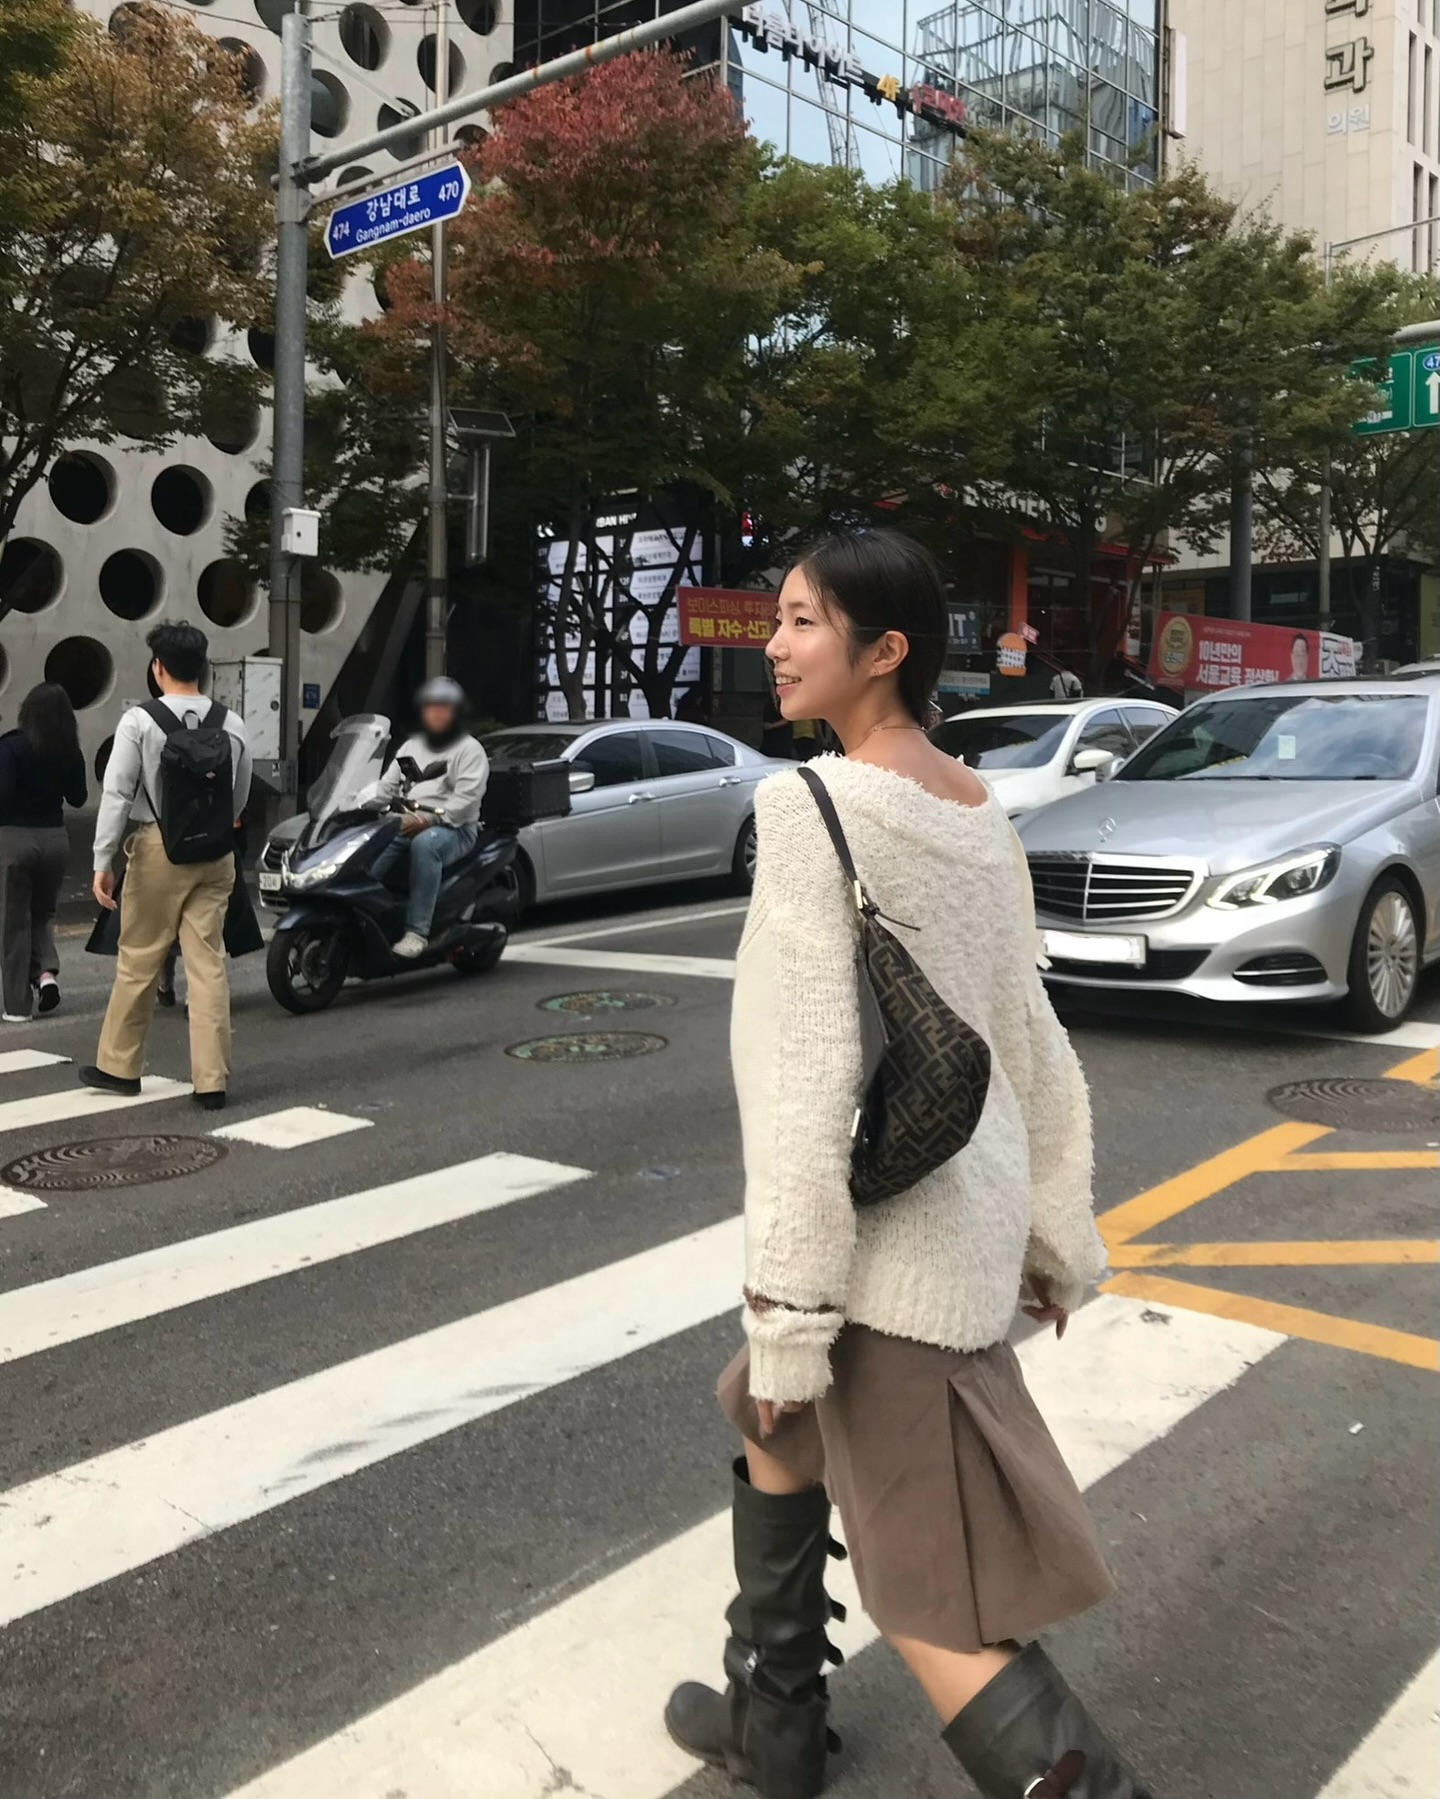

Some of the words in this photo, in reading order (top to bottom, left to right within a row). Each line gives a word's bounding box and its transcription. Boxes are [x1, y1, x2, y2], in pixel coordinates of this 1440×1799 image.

[1327, 104, 1370, 134] 의원
[366, 184, 421, 222] 강남대로
[438, 181, 459, 202] 470
[333, 221, 350, 241] 474
[356, 208, 431, 243] Gangnam-daero
[687, 597, 740, 615] 보이스피싱
[1199, 640, 1242, 664] 10년만의
[1196, 663, 1242, 687] 서울교육
